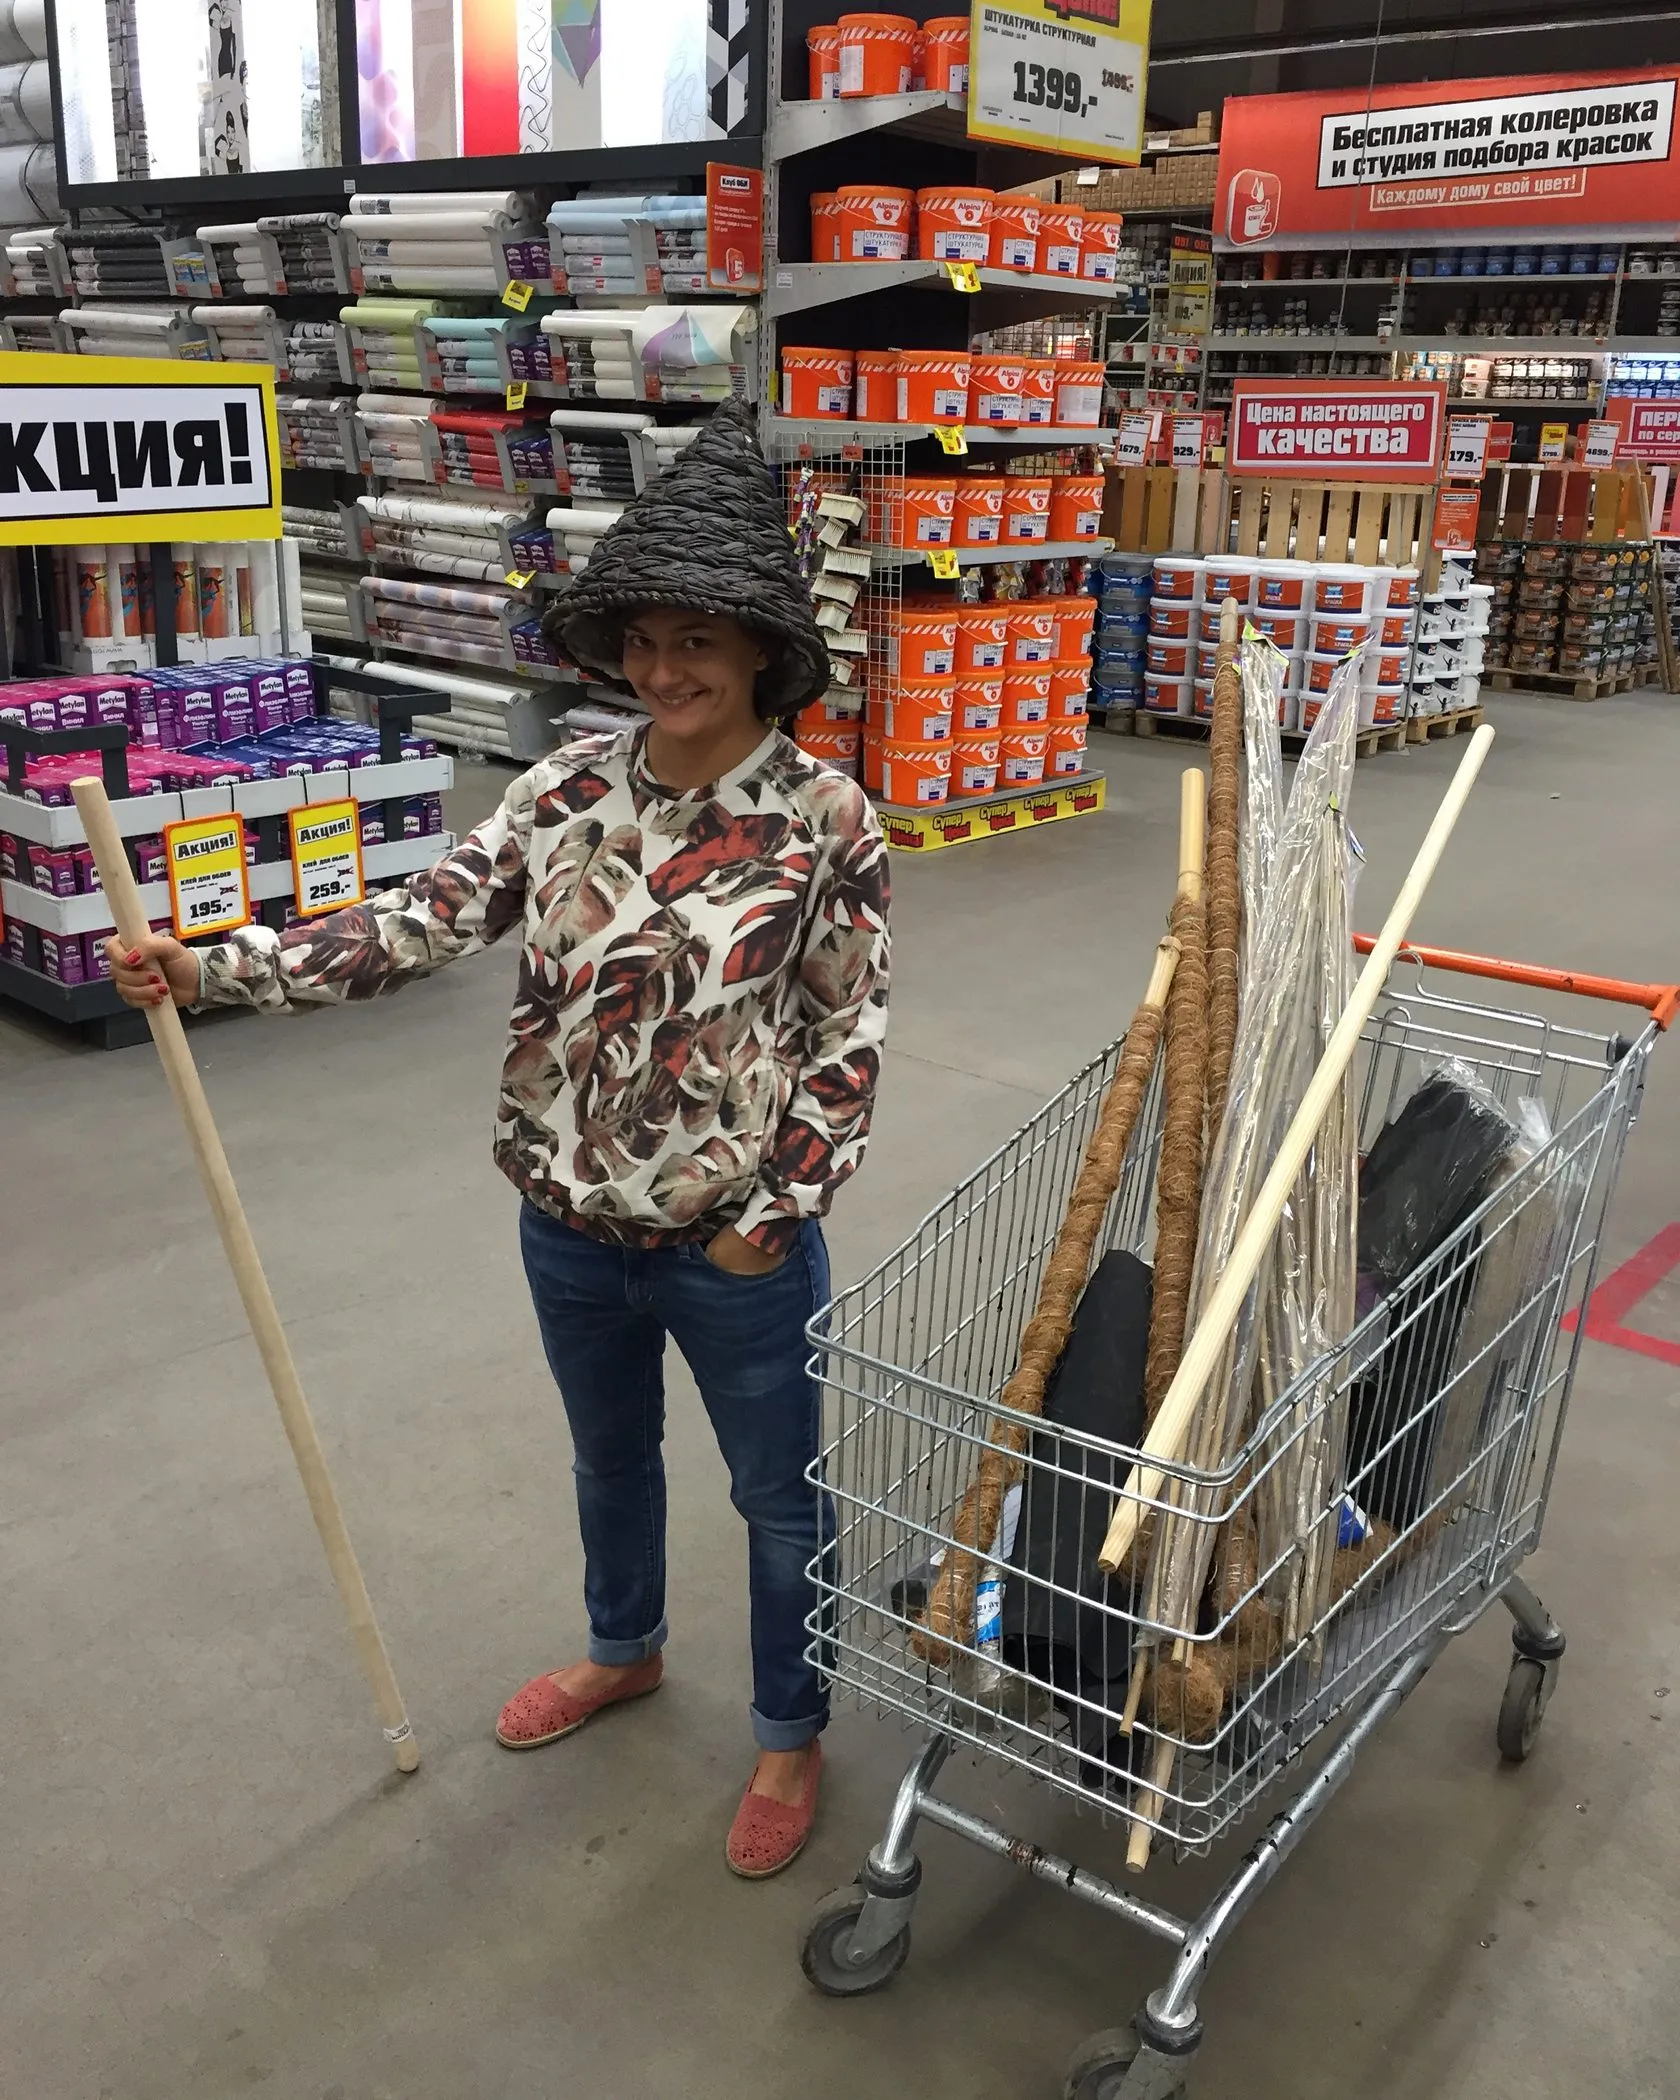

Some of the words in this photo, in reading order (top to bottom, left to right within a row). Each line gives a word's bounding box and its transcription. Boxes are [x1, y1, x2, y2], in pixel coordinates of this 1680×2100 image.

[984, 9, 1041, 34] ШТУКАТУРКА
[1042, 23, 1097, 48] СТРУКТУРНАЯ
[1013, 60, 1098, 118] 1399,-
[1332, 115, 1494, 151] Бесплатная
[1500, 99, 1659, 137] колеровка
[1331, 159, 1347, 178] и
[1353, 152, 1437, 179] студия
[1443, 139, 1545, 169] подбора
[1556, 131, 1655, 161] красок
[1376, 184, 1447, 204] Каждому
[1450, 181, 1490, 200] дому
[1494, 176, 1530, 195] свой
[1534, 174, 1577, 194] цвет!
[876, 202, 899, 211] Alpina
[958, 203, 981, 212] Alpina
[1247, 402, 1296, 425] Цена
[1301, 402, 1426, 425] настоящего
[1640, 411, 1680, 427] ПЕР
[1258, 428, 1410, 455] качества
[1638, 431, 1654, 440] по
[0, 402, 253, 502] кция!
[1118, 444, 1145, 455] 1679,-
[1173, 446, 1200, 457] 929,-
[1449, 450, 1483, 463] 179,-
[288, 673, 308, 682] Metylan
[261, 682, 283, 691] Metylan
[99, 695, 126, 705] Metylan
[186, 697, 211, 706] Metylan
[226, 691, 248, 700] Metylan
[31, 707, 54, 717] etylan
[62, 718, 84, 727] Винил
[1065, 785, 1092, 802] Супер
[1024, 795, 1051, 811] Супер
[980, 803, 1008, 821] Супер
[877, 812, 914, 833] Супер
[933, 813, 963, 831] Супер
[300, 819, 351, 842] Акция!
[178, 833, 234, 858] Акция!
[149, 861, 167, 872] Mety
[180, 876, 197, 885] КЛЕЙ
[198, 874, 211, 883] ДЛЯ
[212, 871, 232, 880] ОБОЕВ
[309, 881, 351, 900] 259,-
[190, 900, 233, 918] 195,-
